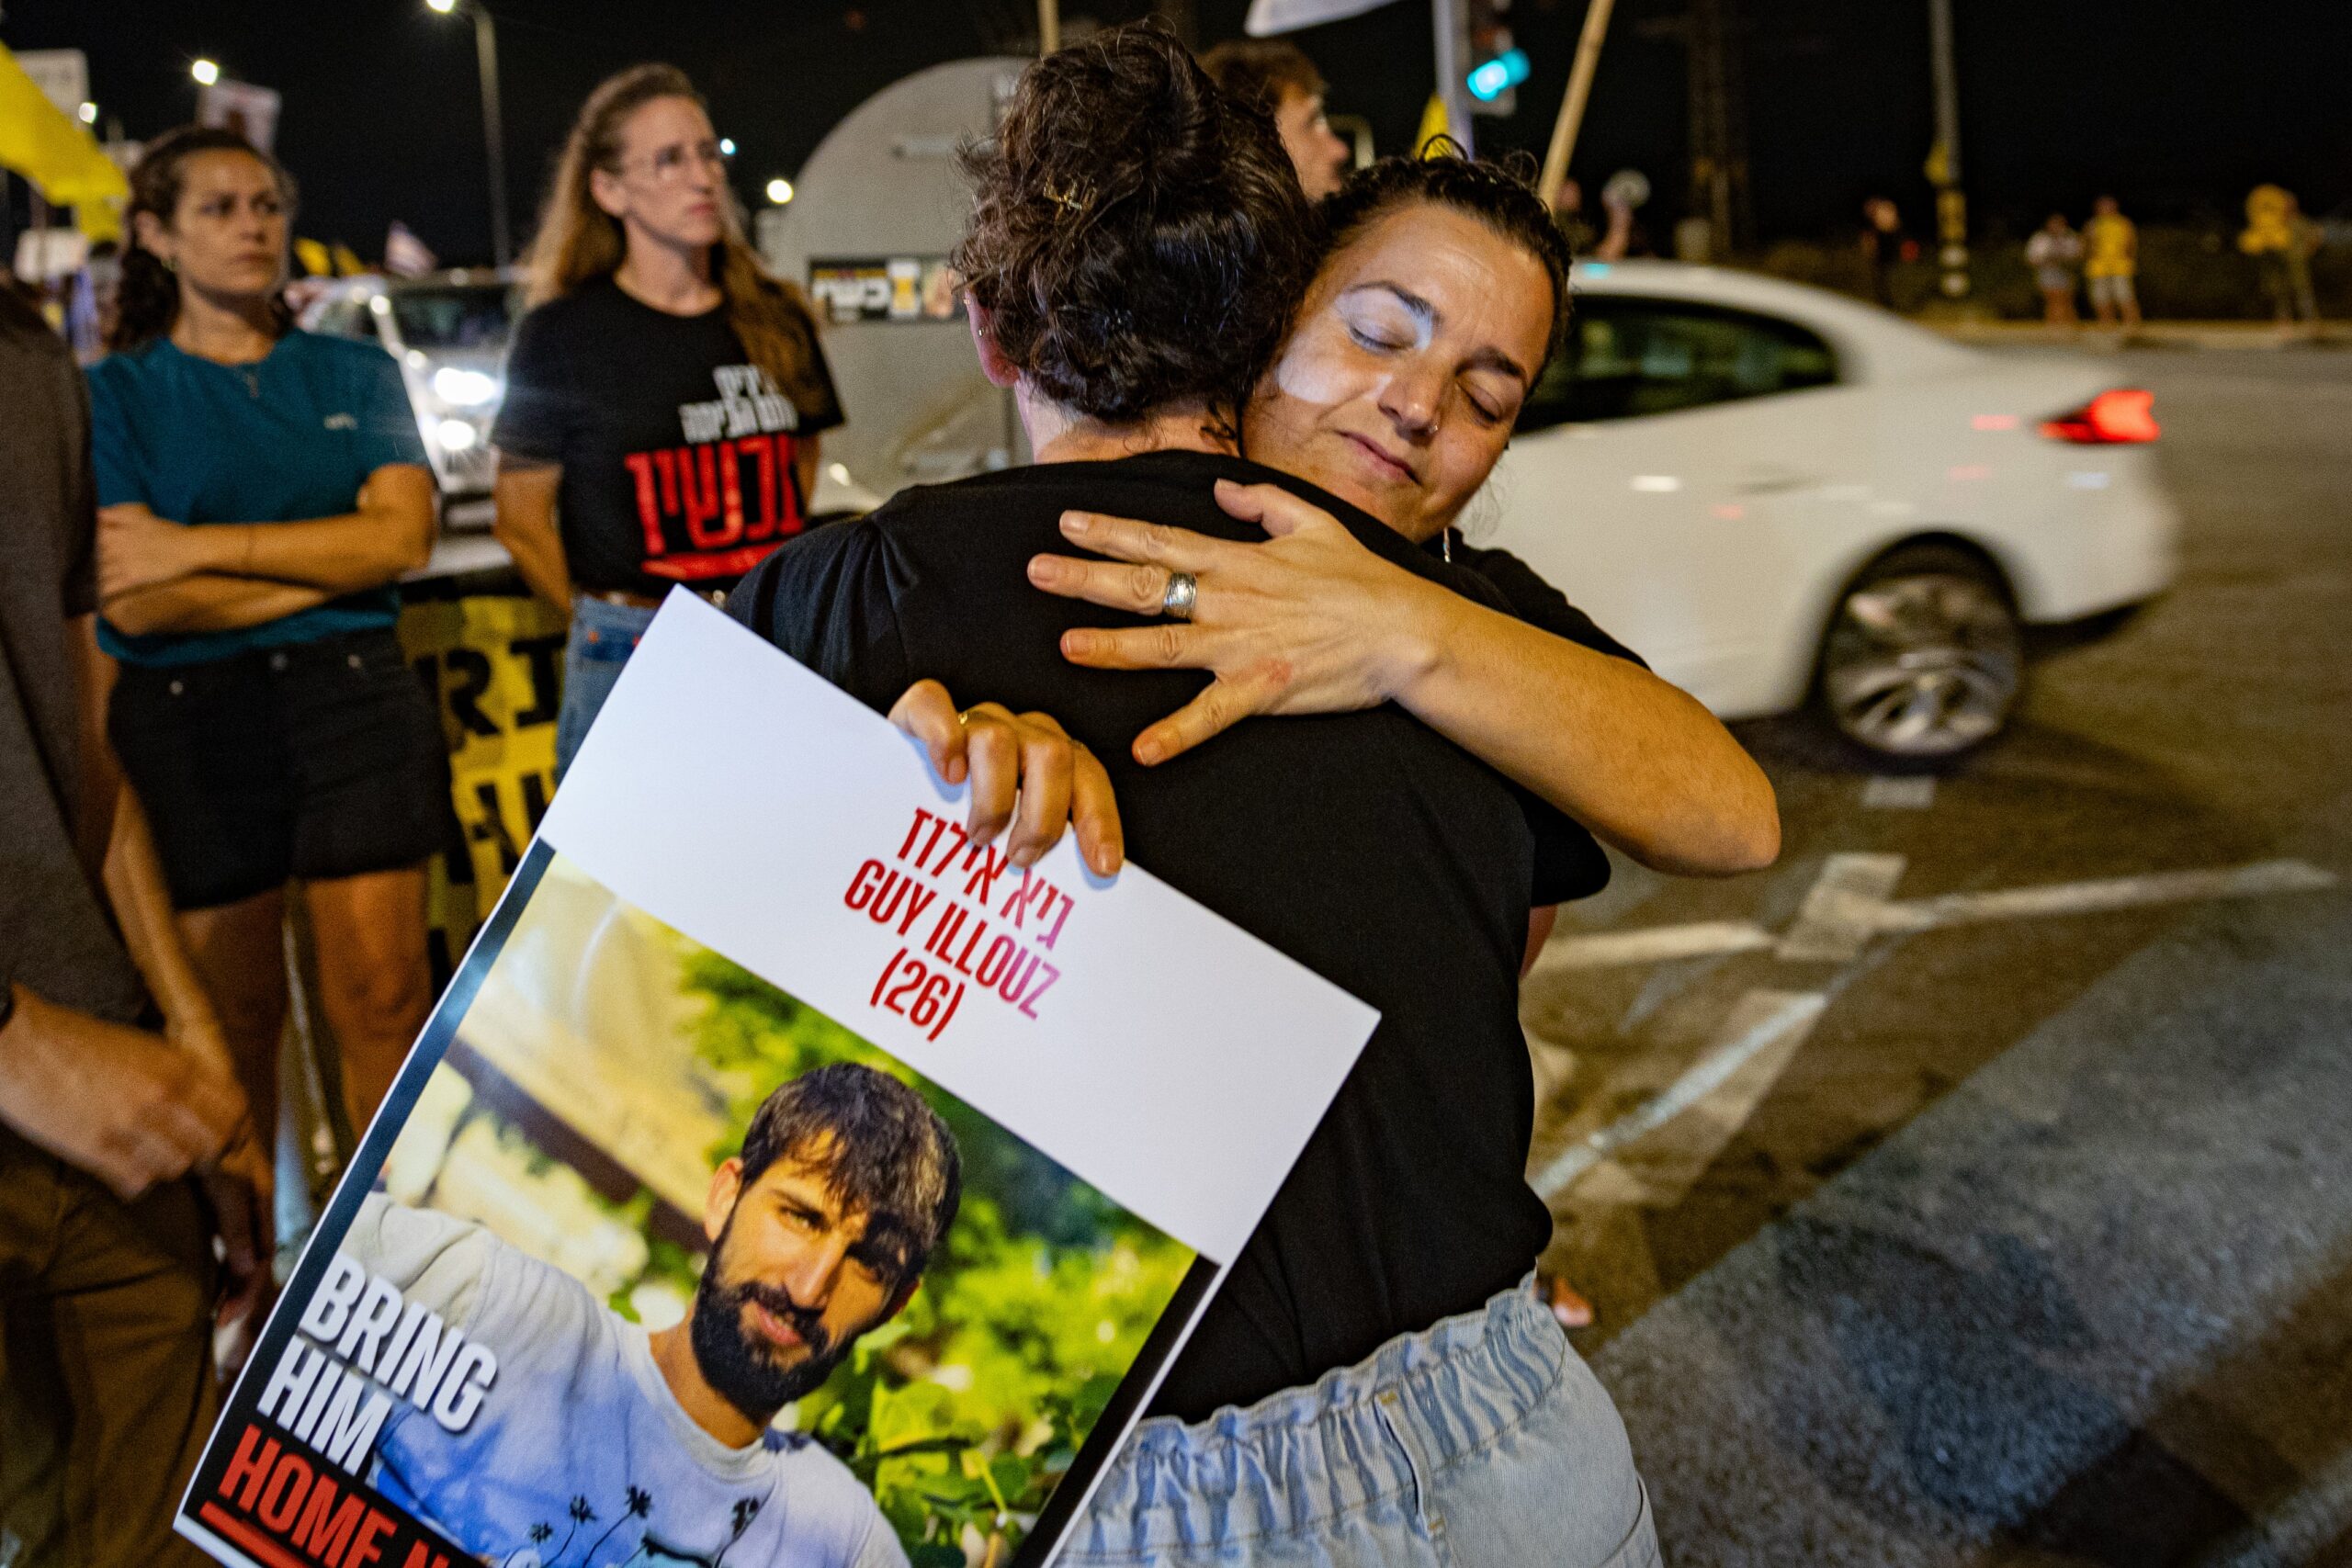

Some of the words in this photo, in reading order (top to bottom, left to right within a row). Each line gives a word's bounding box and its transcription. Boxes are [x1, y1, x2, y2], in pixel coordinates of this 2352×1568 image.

[843, 858, 938, 938] GUY
[923, 900, 1061, 1021] ILLOUZ
[999, 866, 1075, 952] גיא
[869, 946, 967, 1043] (26)
[255, 1333, 393, 1477] HIM
[298, 1250, 499, 1432] BRING
[217, 1423, 399, 1568] HOME
